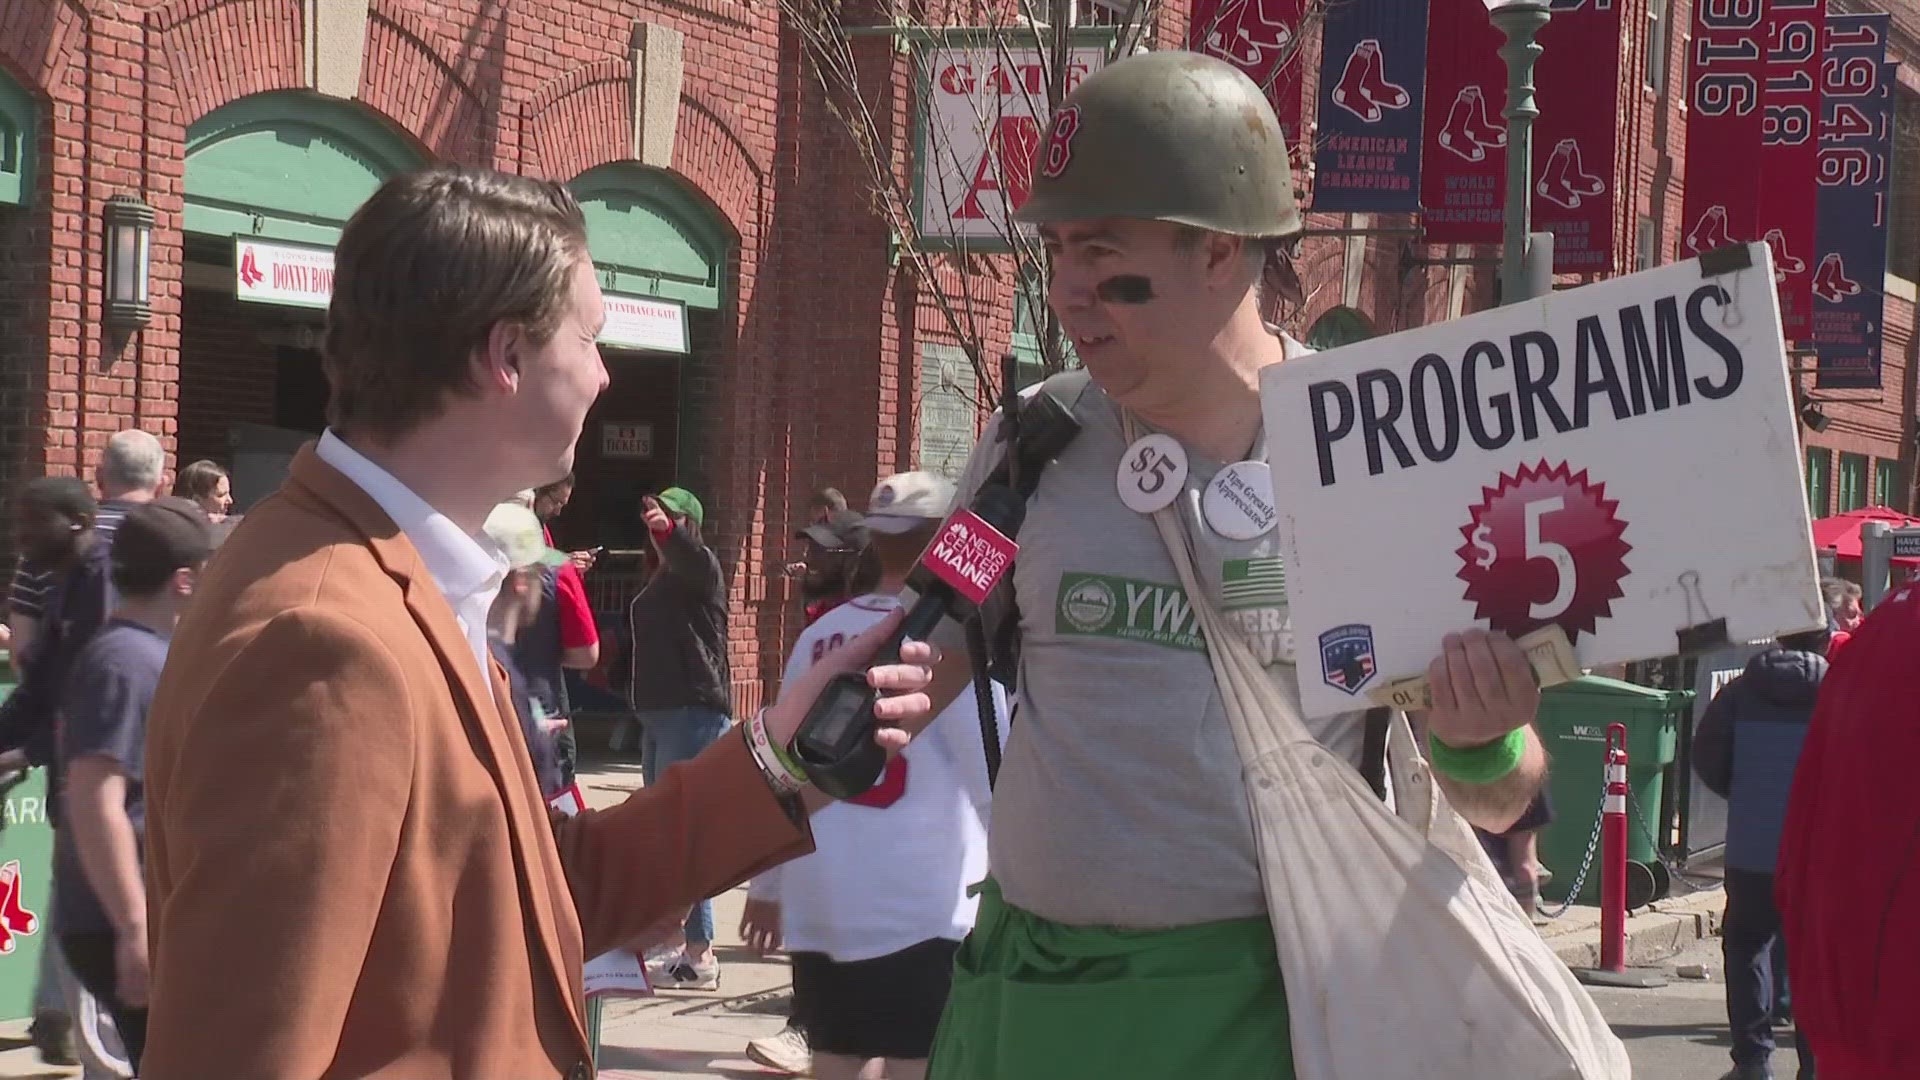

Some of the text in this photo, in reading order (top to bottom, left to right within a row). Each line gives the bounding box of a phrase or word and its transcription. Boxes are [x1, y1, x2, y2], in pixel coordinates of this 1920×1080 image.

[939, 64, 1088, 96] GATE
[1815, 25, 1878, 186] 1946
[1042, 106, 1082, 178] B
[1328, 136, 1408, 153] AMERICAN
[1337, 154, 1396, 172] LEAGUE
[1321, 171, 1410, 191] CHAMPIONS
[1445, 175, 1496, 190] WORLD
[615, 303, 656, 317] ENTRANCE
[657, 310, 678, 321] GATE
[1308, 284, 1744, 488] PROGRAMS
[1130, 446, 1177, 494] $5
[1225, 468, 1246, 492] Tips
[1215, 478, 1269, 530] Appreciated
[932, 541, 993, 591] MAINE
[943, 531, 1000, 577] CENTER
[967, 532, 1007, 567] NEWS
